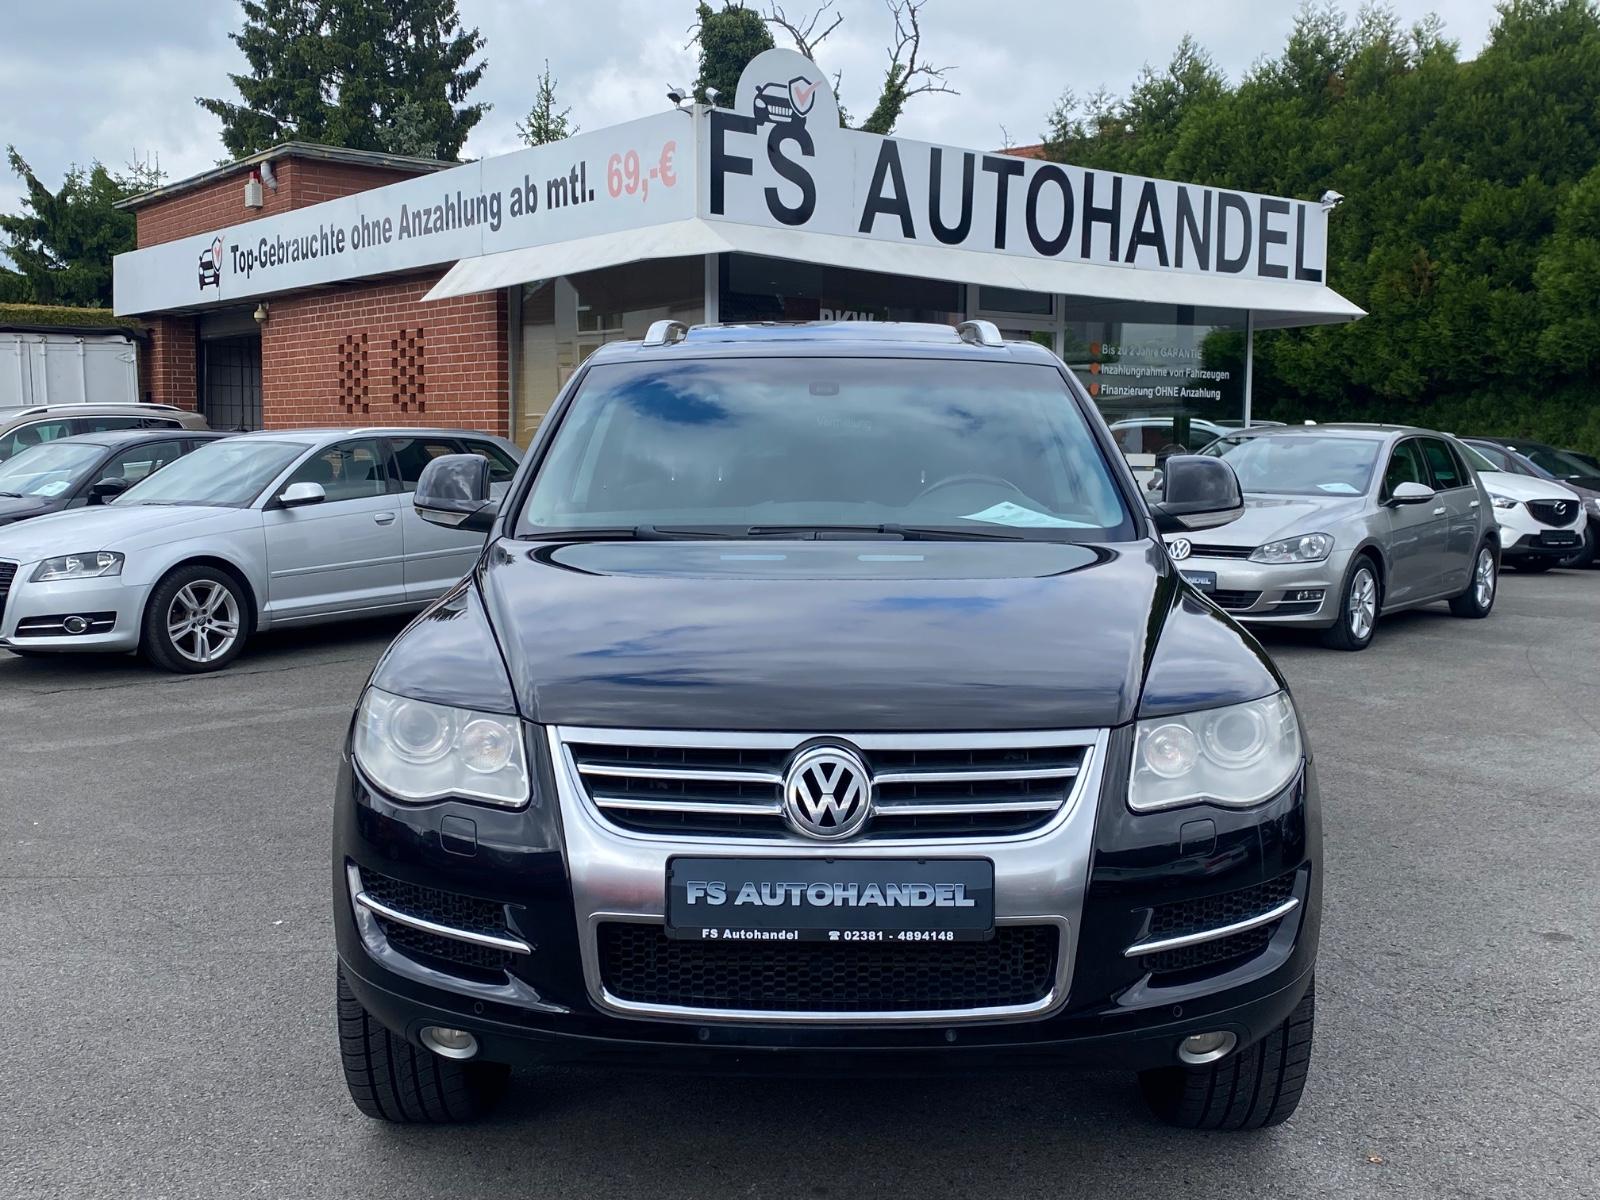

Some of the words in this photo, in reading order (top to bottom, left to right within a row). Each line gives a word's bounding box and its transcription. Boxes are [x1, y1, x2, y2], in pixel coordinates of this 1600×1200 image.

[710, 112, 816, 226] FS
[858, 139, 1324, 283] AUTOHANDEL
[230, 224, 345, 279] Top-Gebrauchte
[351, 214, 393, 250] ohne
[398, 191, 502, 240] Anzahlung
[510, 174, 538, 218] ab
[547, 161, 595, 209] mtl.
[607, 140, 677, 203] 69,-€
[1102, 344, 1116, 355] Bis
[1117, 347, 1129, 356] zu
[1136, 345, 1159, 357] Jahre
[1160, 347, 1203, 360] GARANTIE
[1101, 365, 1168, 378] Inzahlungnahme
[1169, 368, 1184, 378] von
[1185, 368, 1230, 382] Fahrzeugen
[1101, 384, 1153, 399] Finanzierung
[1155, 386, 1179, 398] OHNE
[1180, 388, 1221, 400] Anzahlung
[687, 881, 727, 905] FS
[734, 881, 975, 907] AUTOHANDEL
[702, 929, 719, 939] FS
[723, 929, 799, 940] Autohandel
[844, 931, 883, 941] 02381
[898, 931, 954, 941] 4894148
